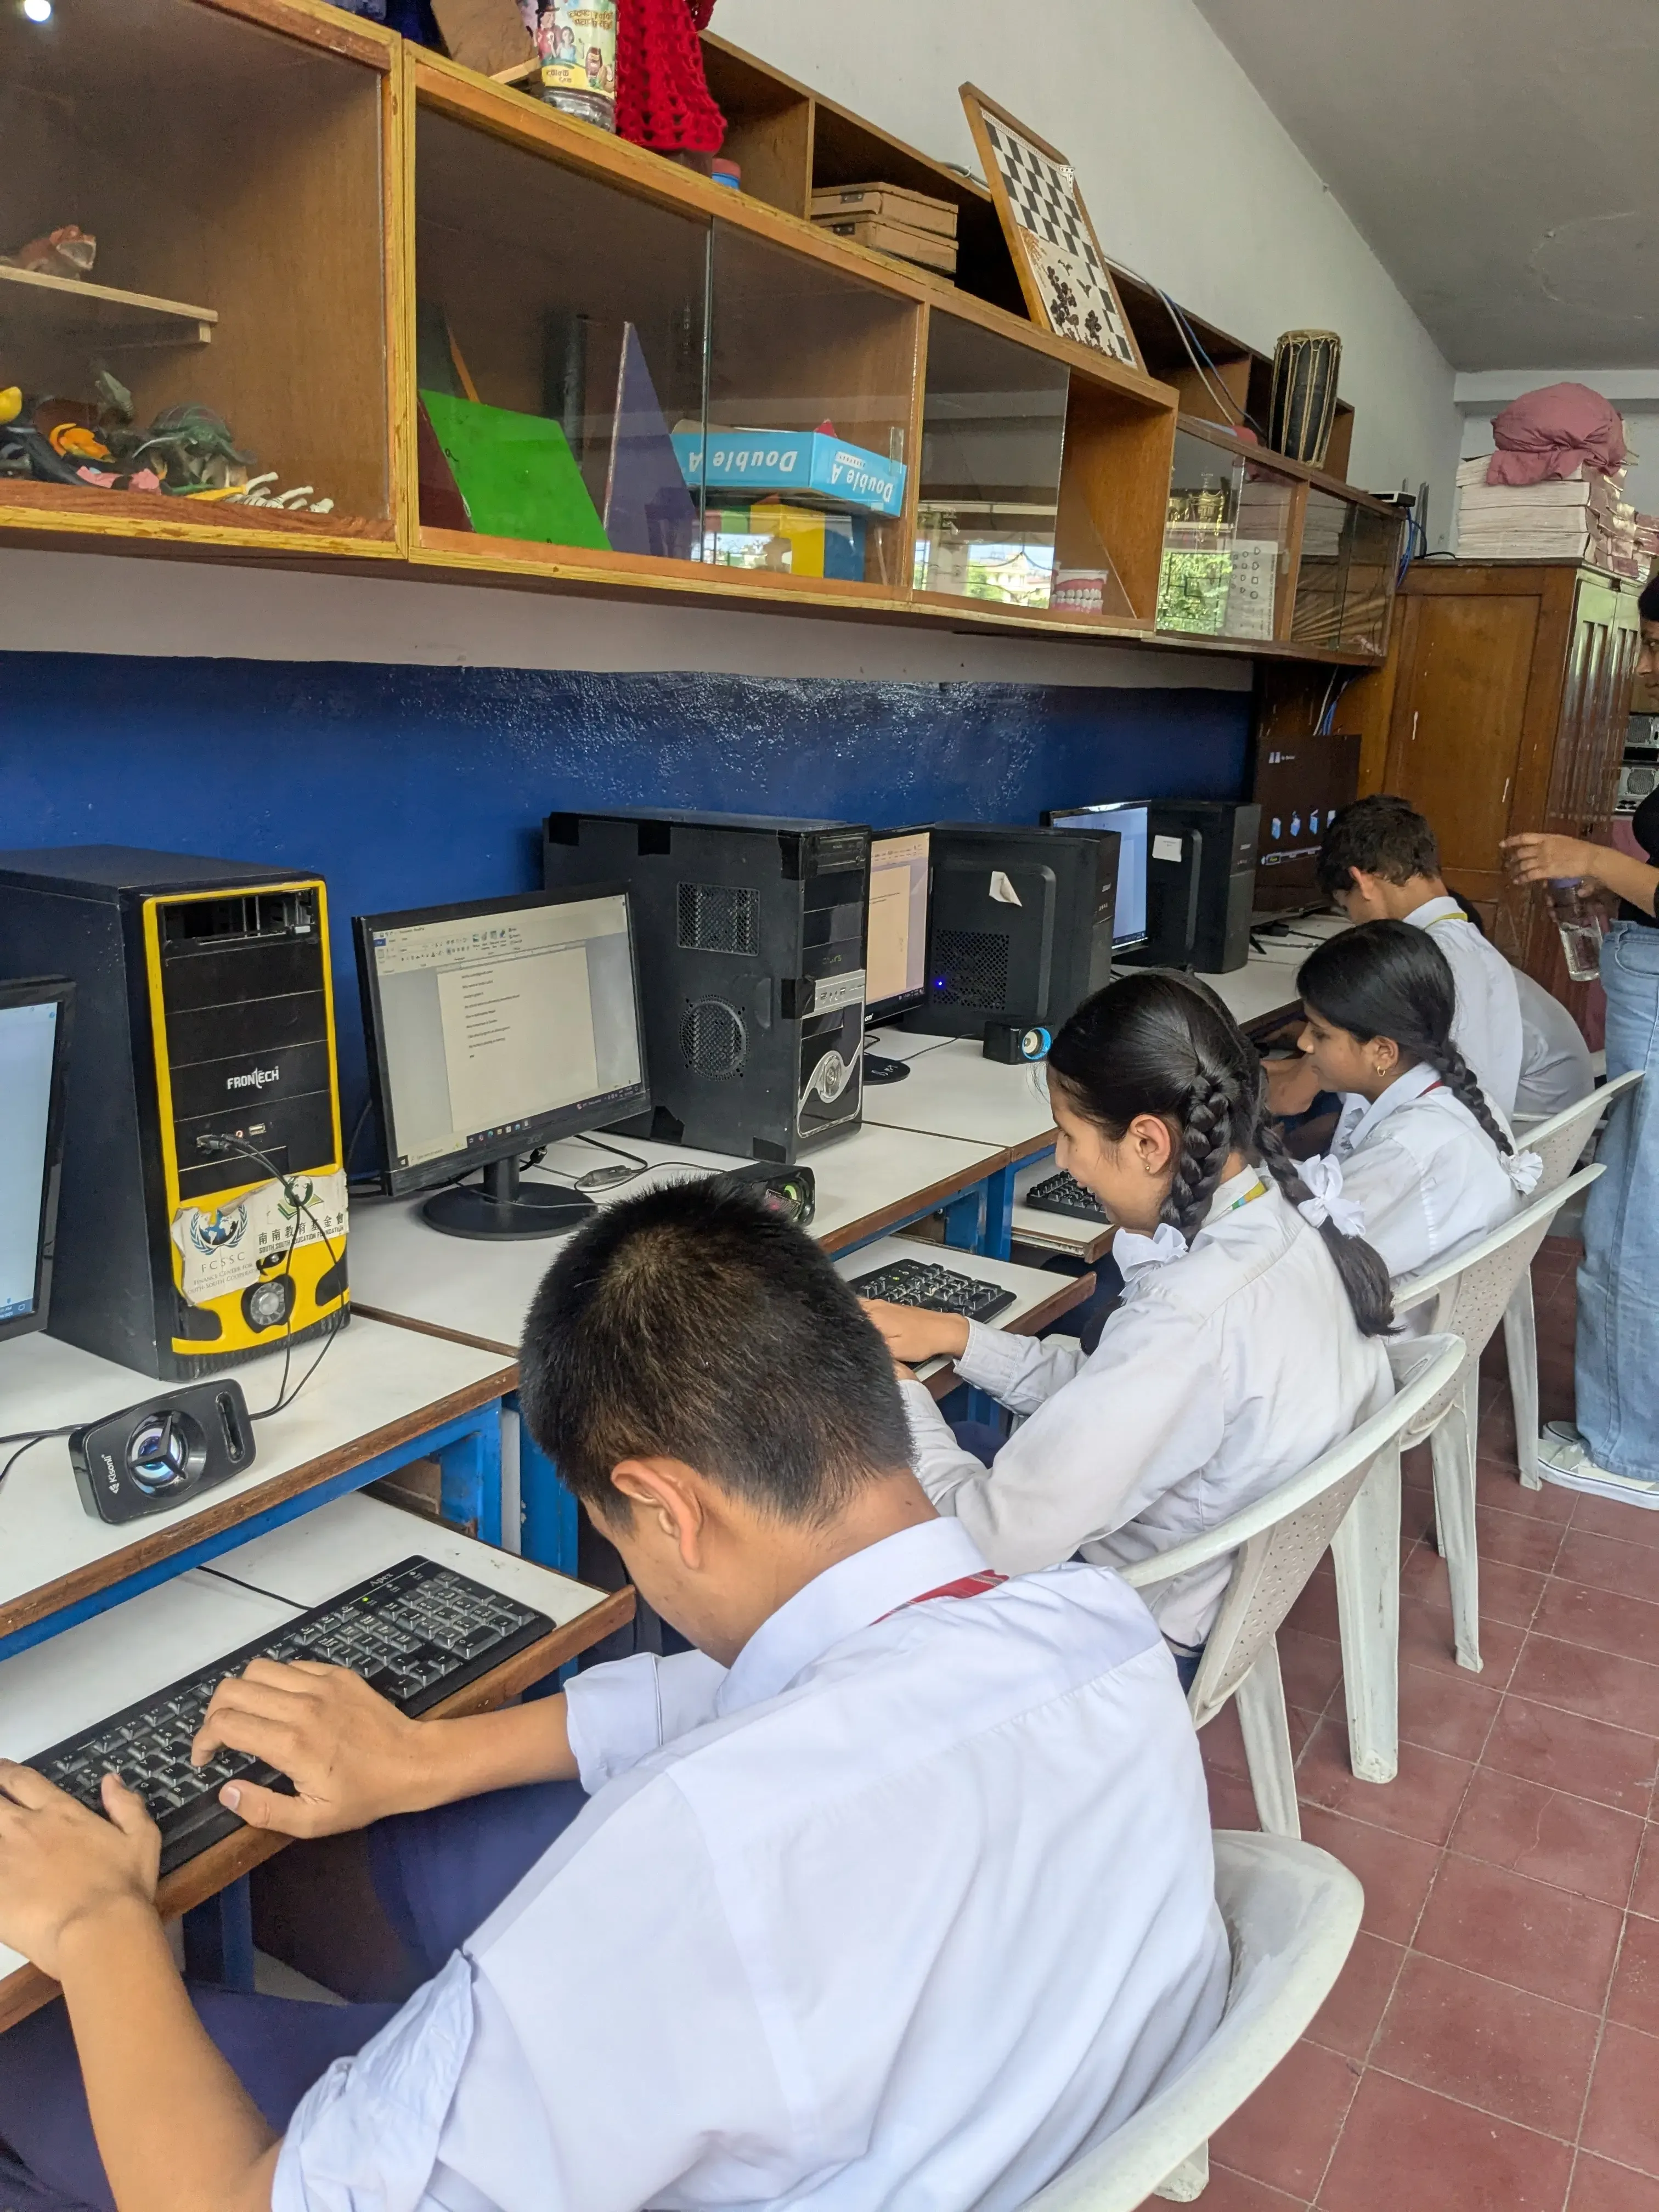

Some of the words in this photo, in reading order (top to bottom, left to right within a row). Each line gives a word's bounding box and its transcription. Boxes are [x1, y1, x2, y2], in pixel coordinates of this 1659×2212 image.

[689, 452, 703, 472] A
[713, 451, 798, 472] Double
[831, 463, 843, 484] A
[847, 469, 894, 503] Double
[259, 1243, 274, 1254] SOUTH
[275, 1239, 290, 1250] SOUTH
[293, 1233, 316, 1244] DUCATION
[370, 1573, 393, 1587] Apex
